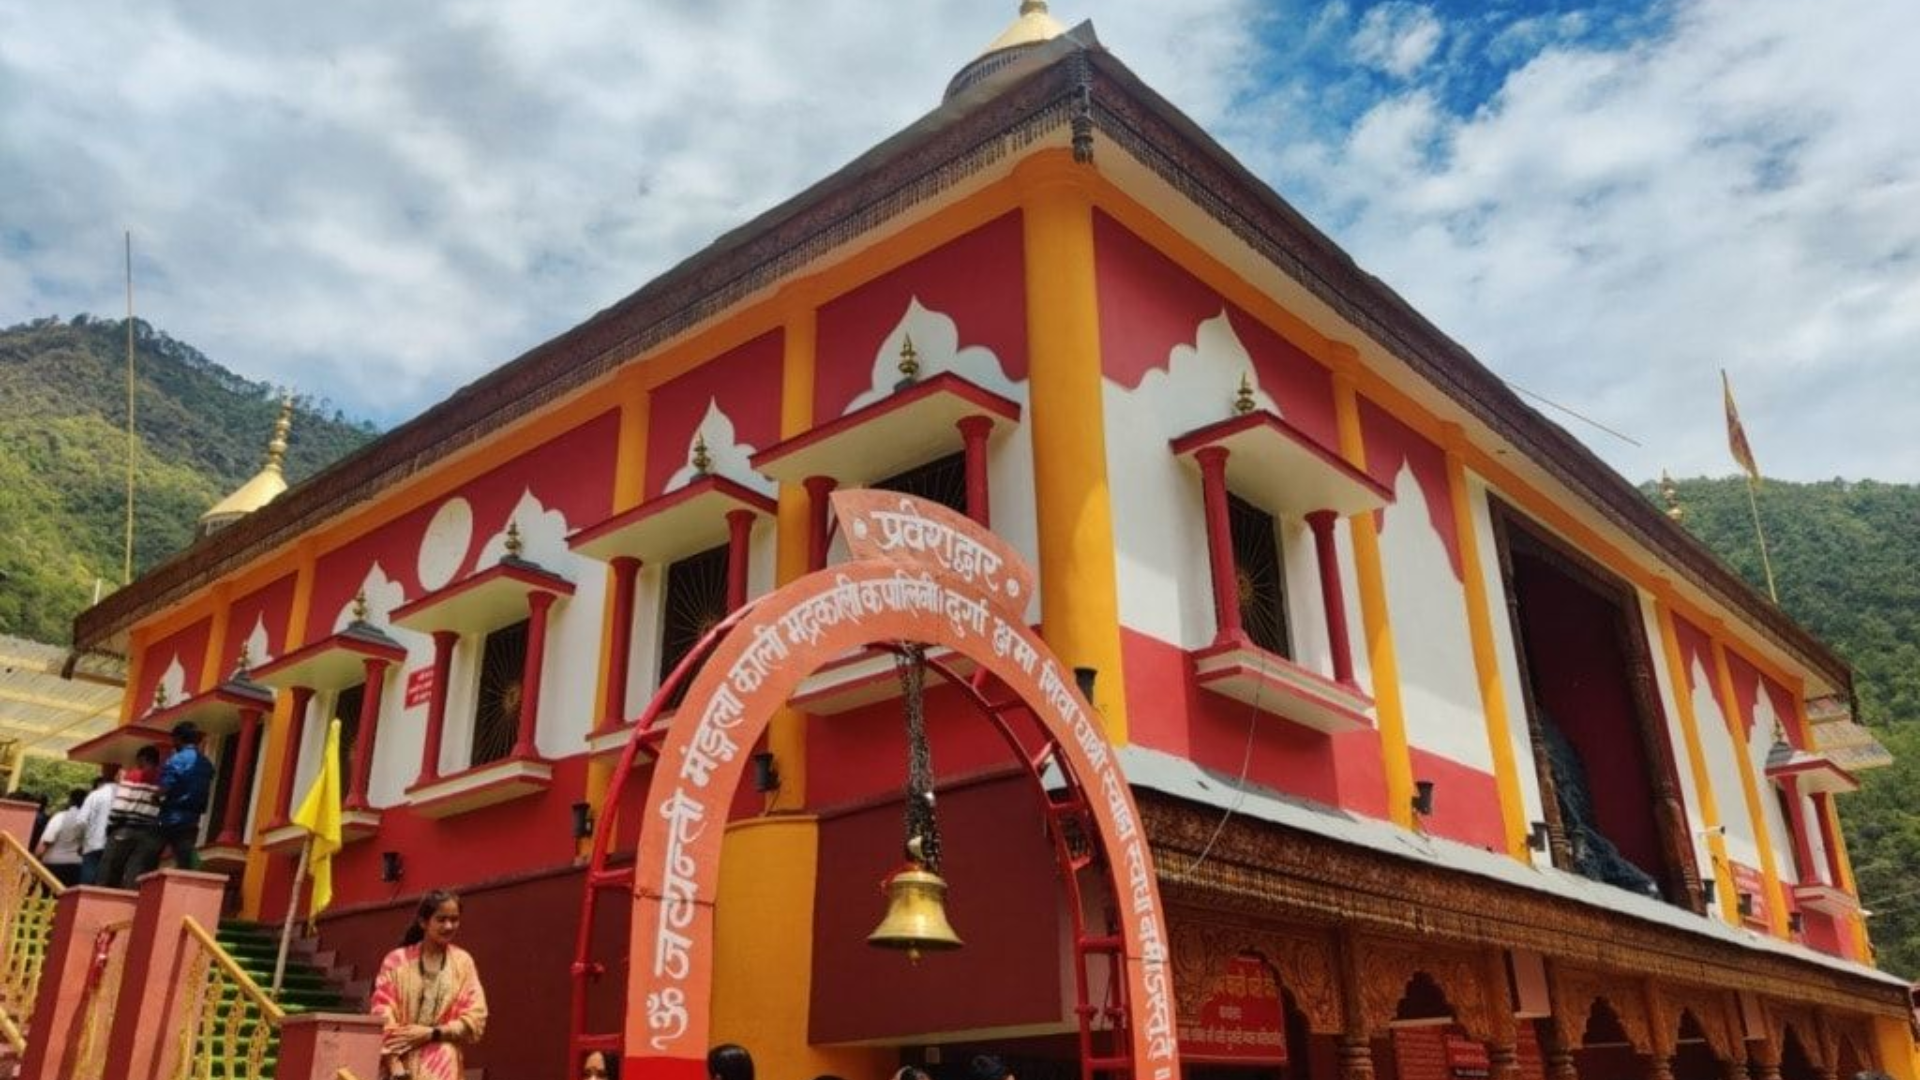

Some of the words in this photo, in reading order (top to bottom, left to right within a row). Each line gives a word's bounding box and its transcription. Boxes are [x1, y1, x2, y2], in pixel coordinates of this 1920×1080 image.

[872, 498, 1003, 592] प्रवेशद्वार
[654, 787, 707, 978] जयन्ती
[727, 623, 789, 694] काली
